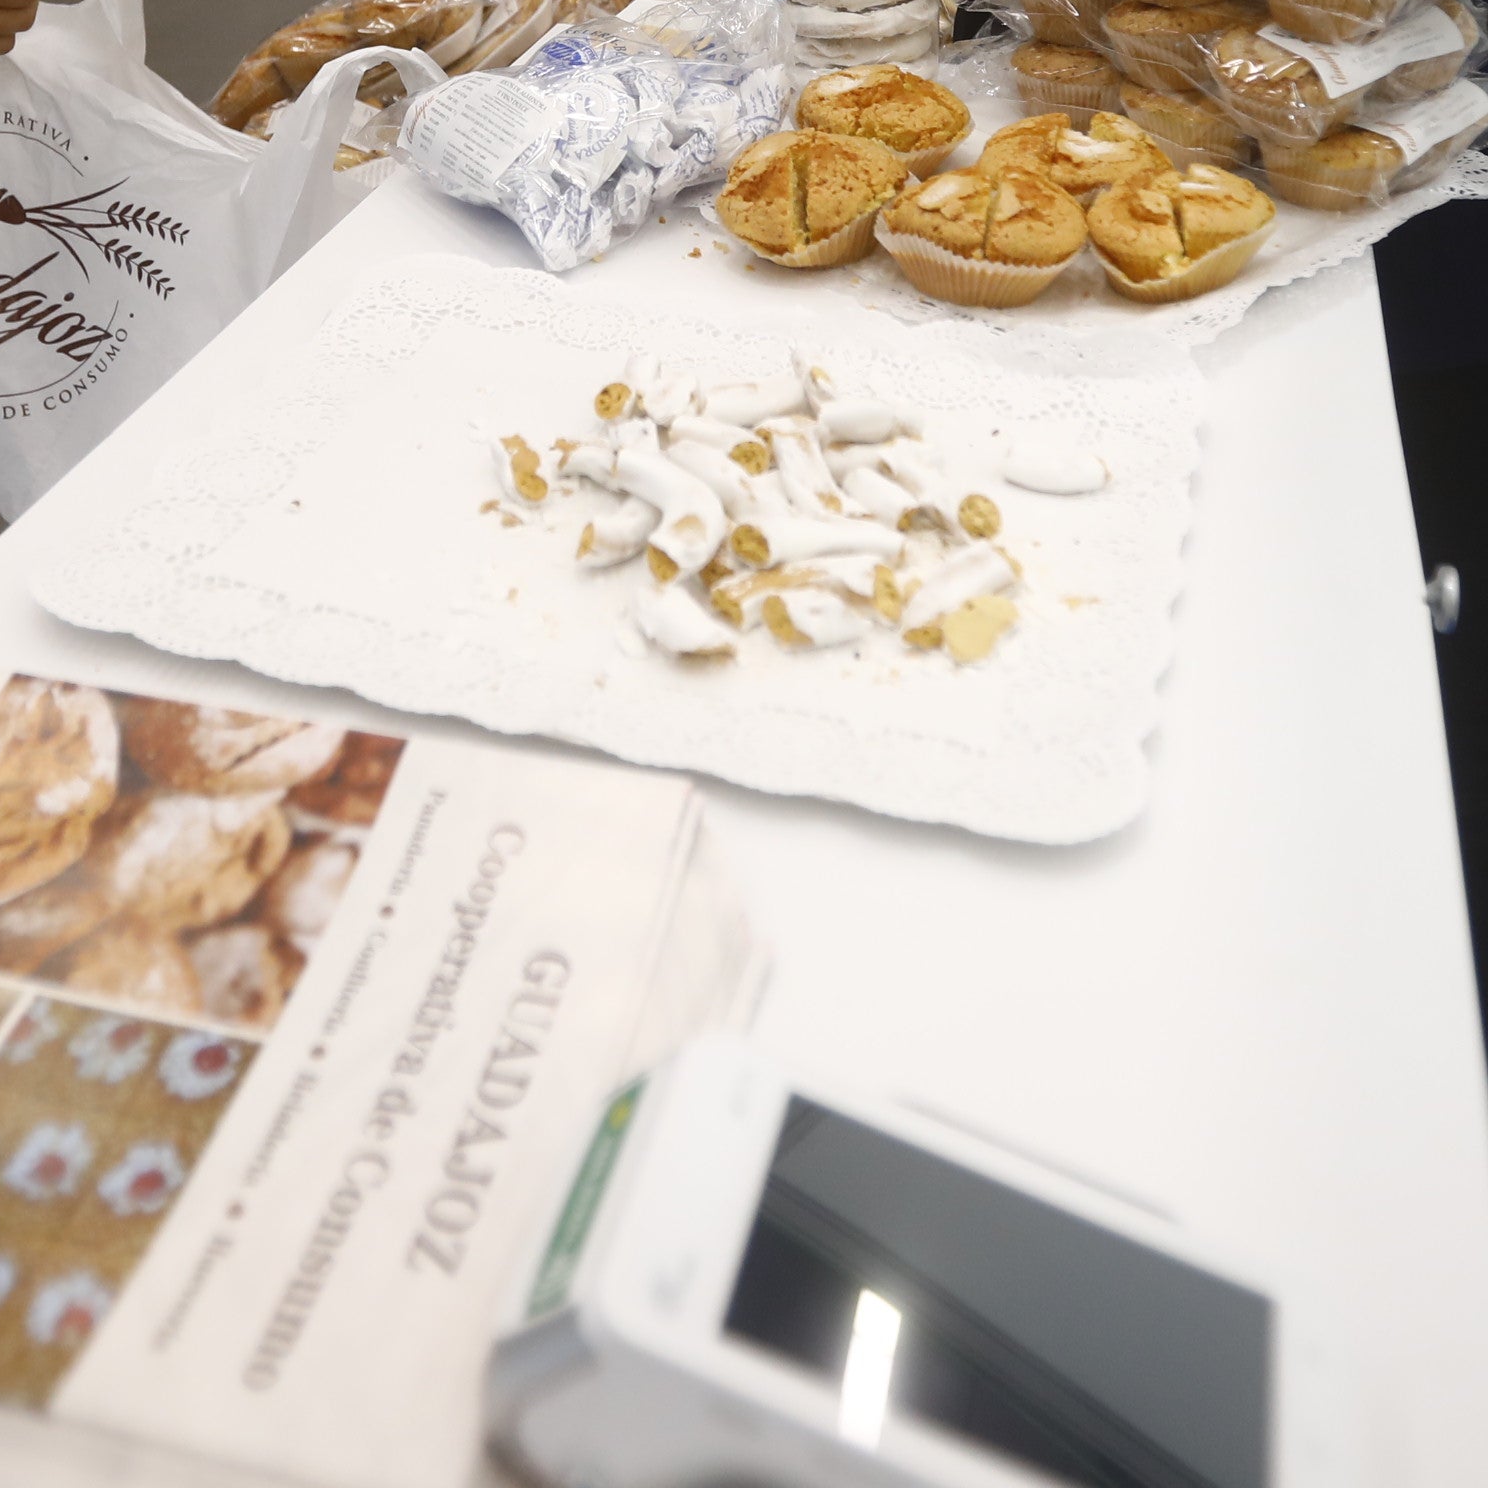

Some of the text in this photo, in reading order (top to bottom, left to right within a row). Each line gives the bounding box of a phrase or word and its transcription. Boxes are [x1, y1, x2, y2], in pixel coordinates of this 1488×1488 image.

[2, 403, 31, 420] DE
[43, 326, 130, 412] CONSUMO
[242, 821, 527, 1394] Cooperativa de Consumo
[406, 946, 574, 1280] GUADAJOZ
